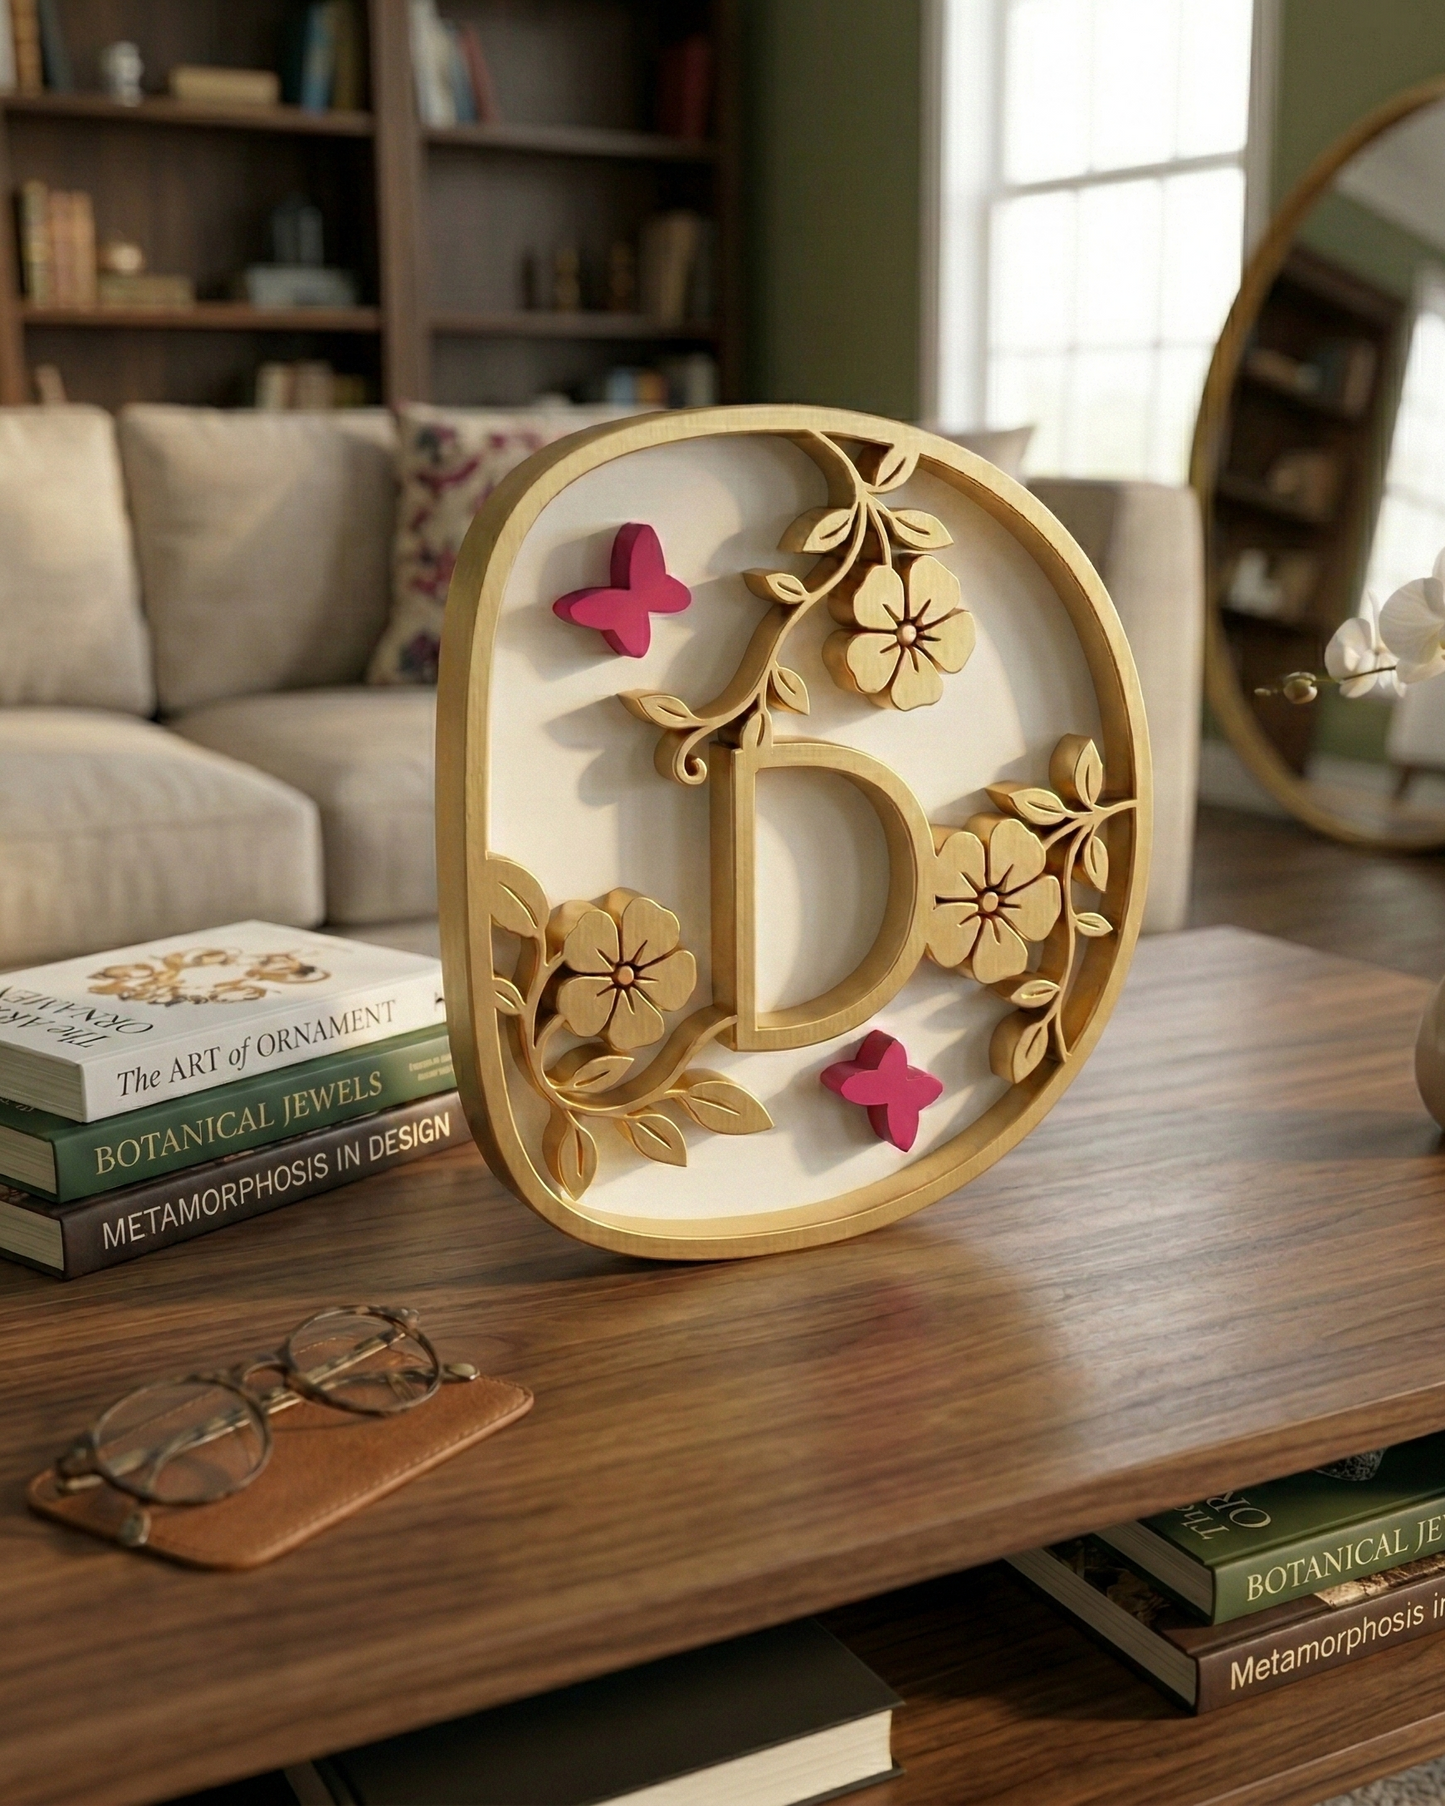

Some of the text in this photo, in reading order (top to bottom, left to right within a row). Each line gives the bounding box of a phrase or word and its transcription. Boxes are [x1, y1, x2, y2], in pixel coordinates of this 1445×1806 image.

[710, 738, 936, 1052] D
[117, 999, 396, 1097] The ART of ORNAMENT
[94, 1071, 383, 1175] BOTANICAL JEWELS
[102, 1112, 450, 1250] METAMORPHOSIS IN DESIGN
[1246, 1514, 1445, 1602] BOTANICAL JE
[1231, 1601, 1424, 1690] Metamorphosis
